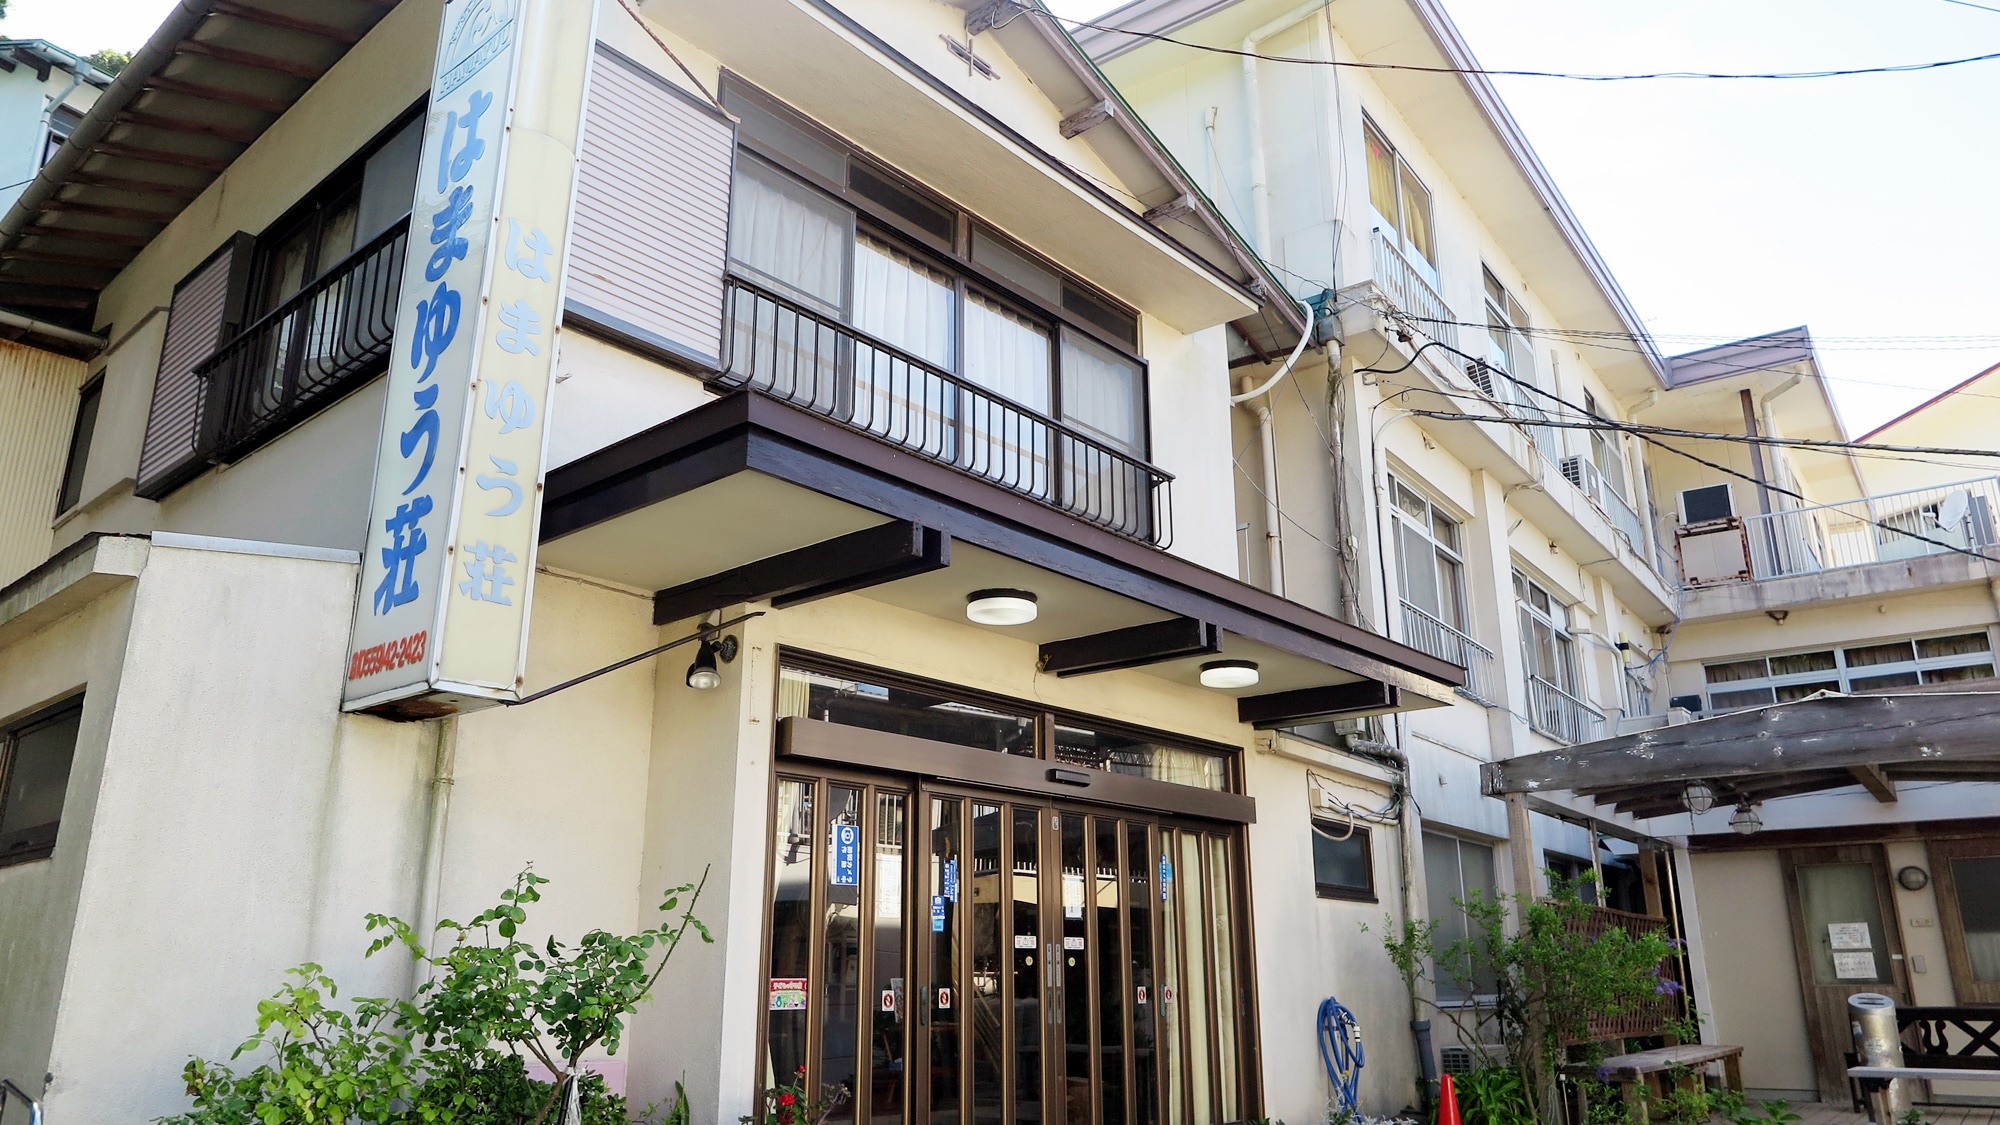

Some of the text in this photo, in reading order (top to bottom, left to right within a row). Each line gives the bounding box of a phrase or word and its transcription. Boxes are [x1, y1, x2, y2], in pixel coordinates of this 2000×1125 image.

[374, 90, 492, 614] はまゆう荘
[458, 217, 554, 606] はまゆう荘
